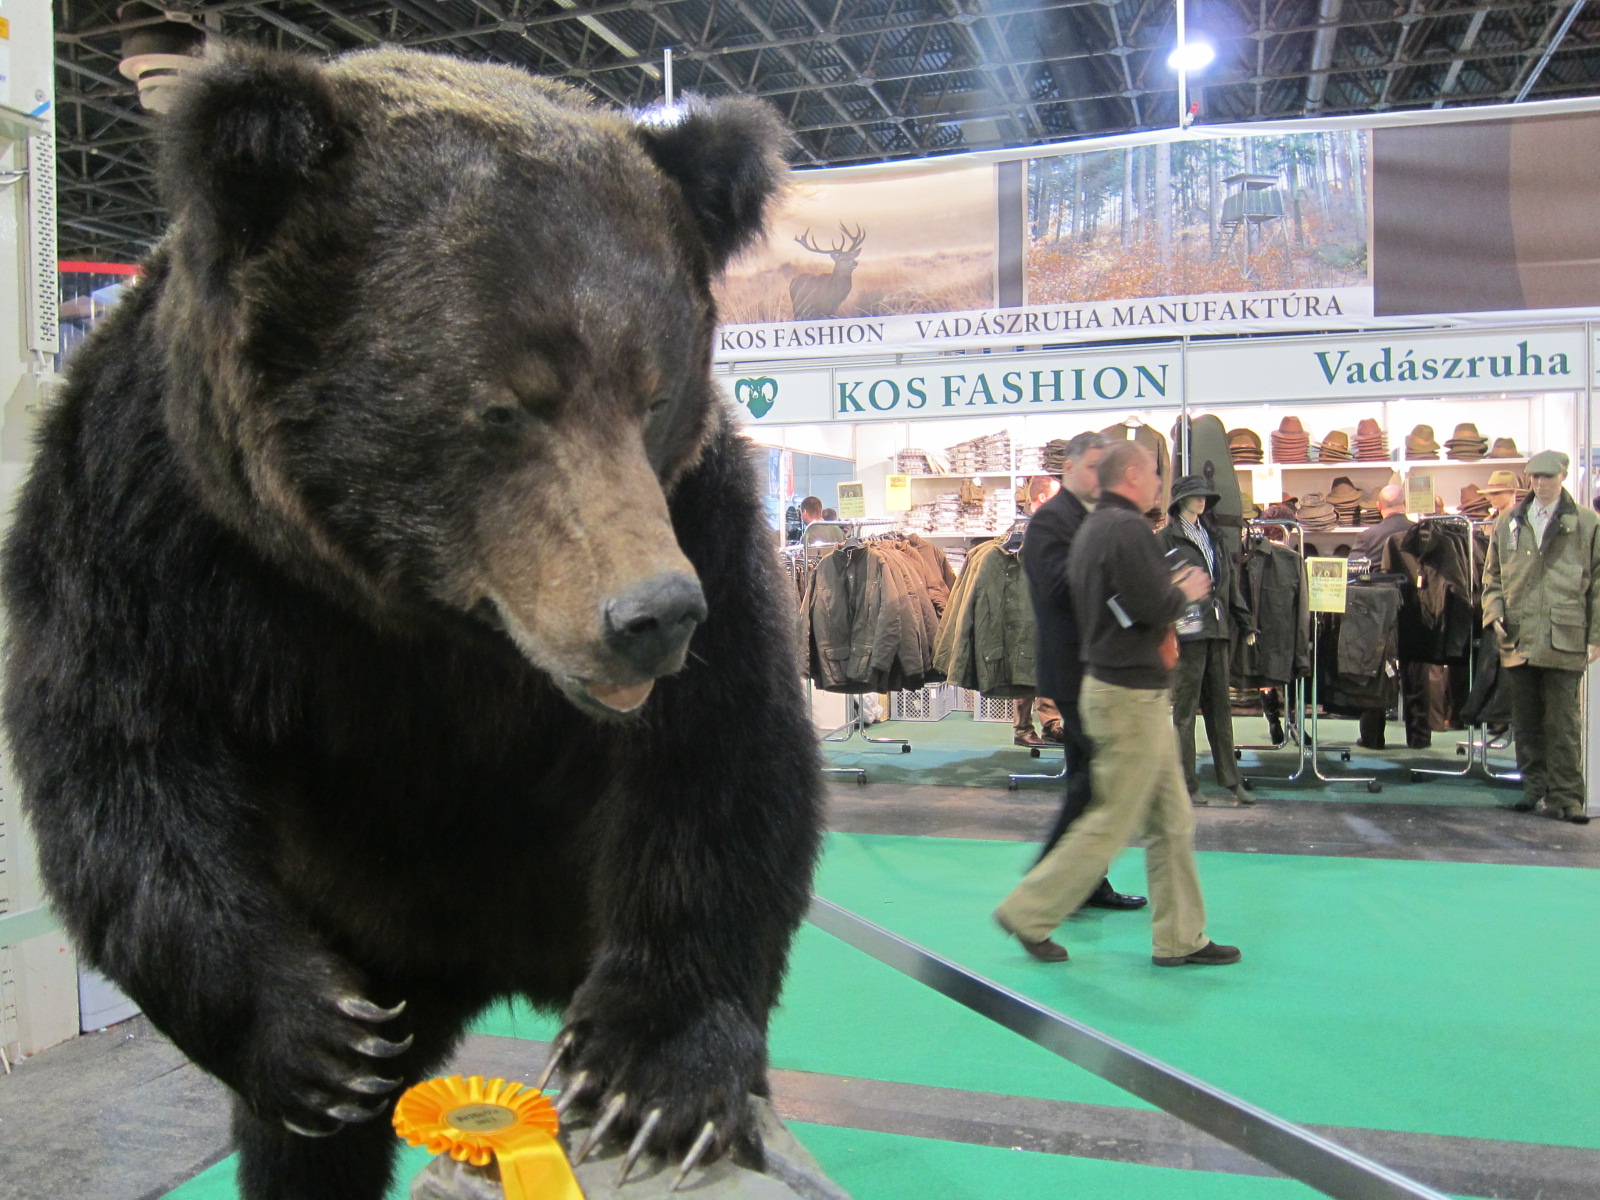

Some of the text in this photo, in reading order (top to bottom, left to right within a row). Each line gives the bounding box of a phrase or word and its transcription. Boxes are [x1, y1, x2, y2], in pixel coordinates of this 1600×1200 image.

[720, 322, 885, 351] KOS FASHION
[915, 291, 1344, 339] VADÁSZRUHA MANUFAKTÚRA
[1313, 340, 1571, 386] Vadászruha
[837, 363, 1170, 413] KOS FASHION
